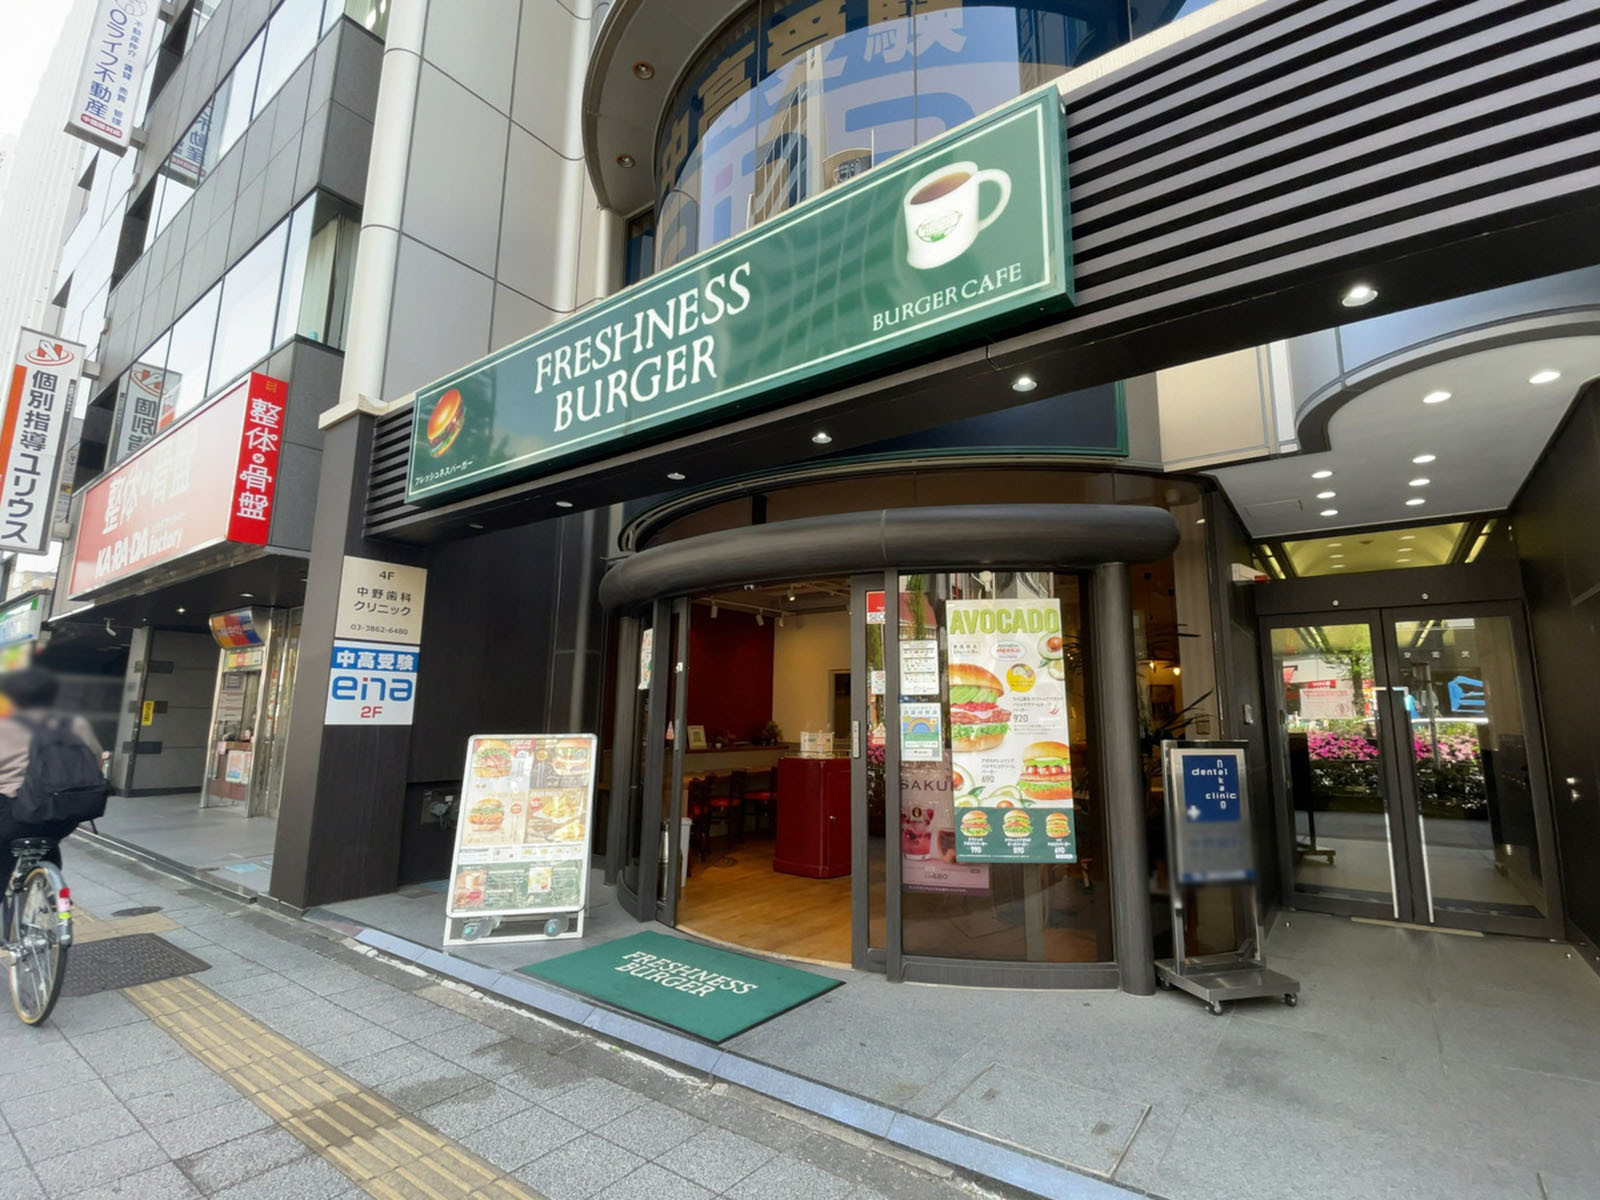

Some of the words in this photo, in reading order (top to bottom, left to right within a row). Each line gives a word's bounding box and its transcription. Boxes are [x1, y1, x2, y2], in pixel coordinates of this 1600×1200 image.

[872, 286, 958, 332] BURGER
[961, 262, 1023, 298] CAFE
[534, 262, 751, 394] FRESHNESS
[554, 335, 718, 432] BURGER
[1, 370, 58, 544] 個別指導ユリウス
[415, 460, 473, 486] フレッシュネスバーガー
[379, 571, 395, 580] 4F
[354, 600, 411, 616] クリニック
[949, 608, 1060, 634] AVOCADO
[336, 650, 414, 671] 中高受験
[332, 676, 413, 701] ena
[360, 706, 383, 718] 2F
[899, 780, 953, 792] SAKU
[1205, 792, 1237, 800] clinic
[615, 963, 716, 998] BURGER
[622, 951, 758, 995] FRESHNESS
